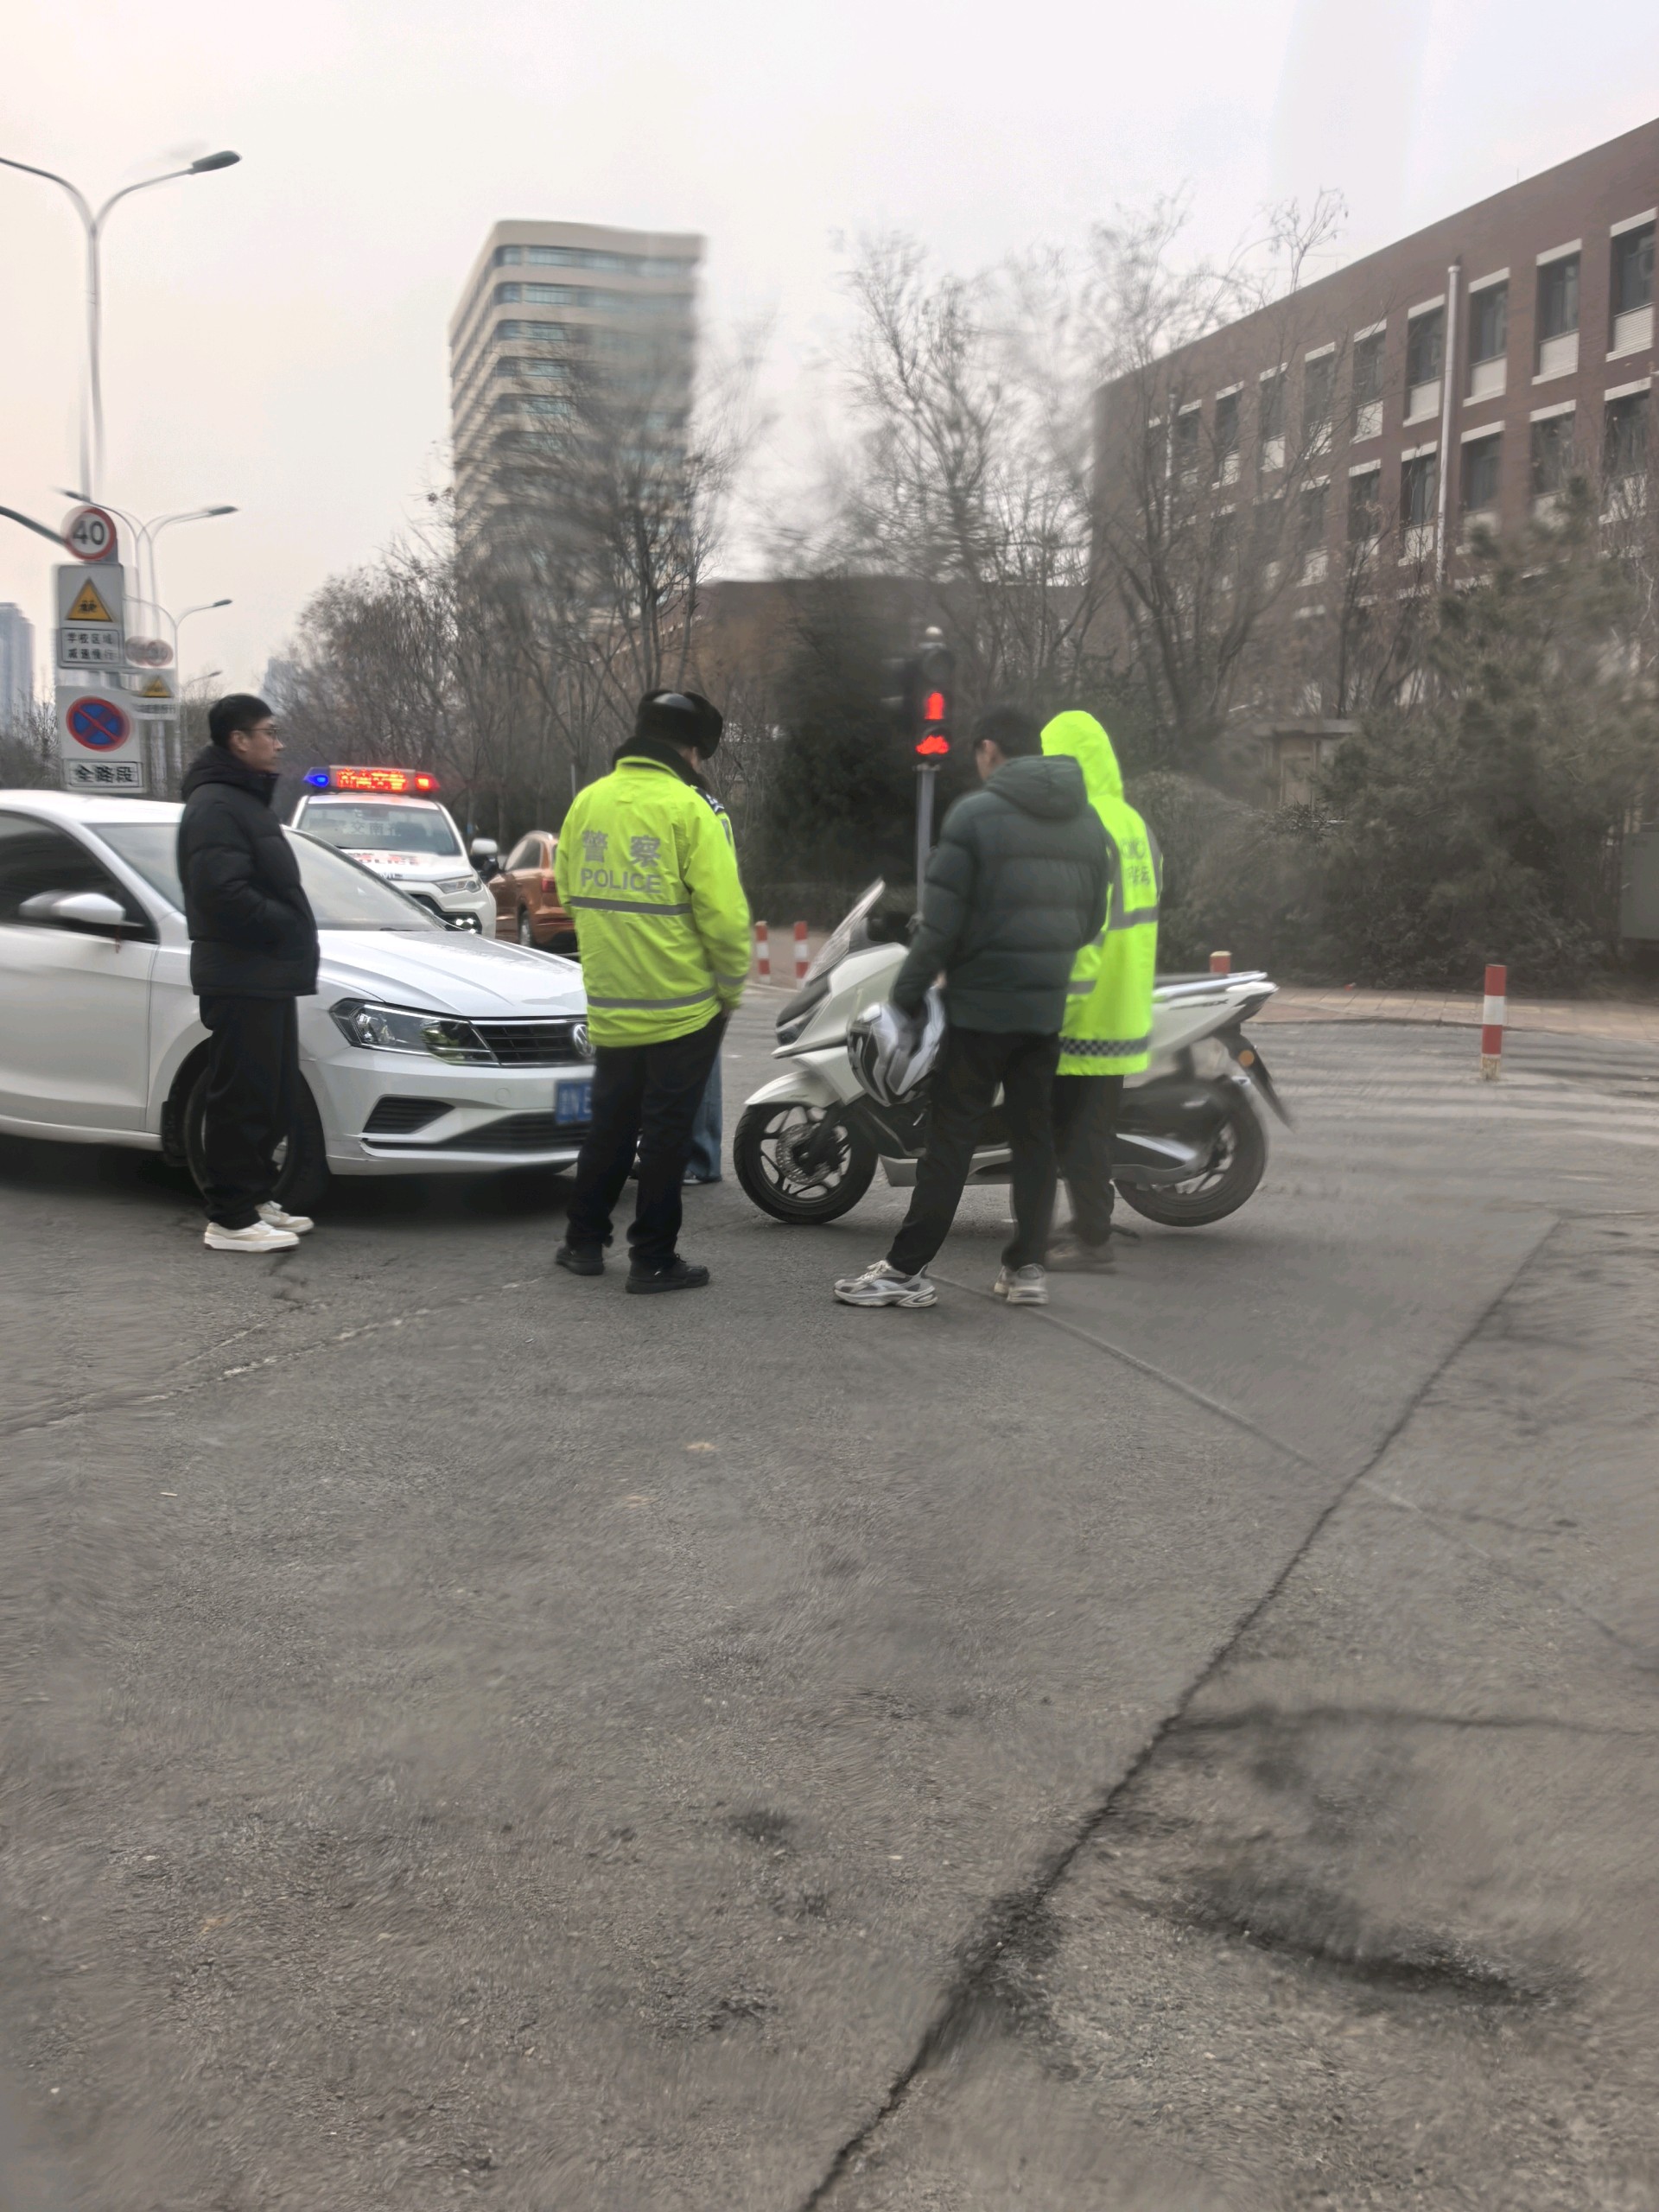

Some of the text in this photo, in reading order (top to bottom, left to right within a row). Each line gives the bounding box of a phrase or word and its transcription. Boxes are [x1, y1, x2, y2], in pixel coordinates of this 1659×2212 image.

[73, 520, 105, 545] 40
[67, 632, 113, 645] 学校区域
[75, 764, 134, 783] 全路段
[582, 829, 662, 868] 警察
[580, 867, 662, 893] POLICE
